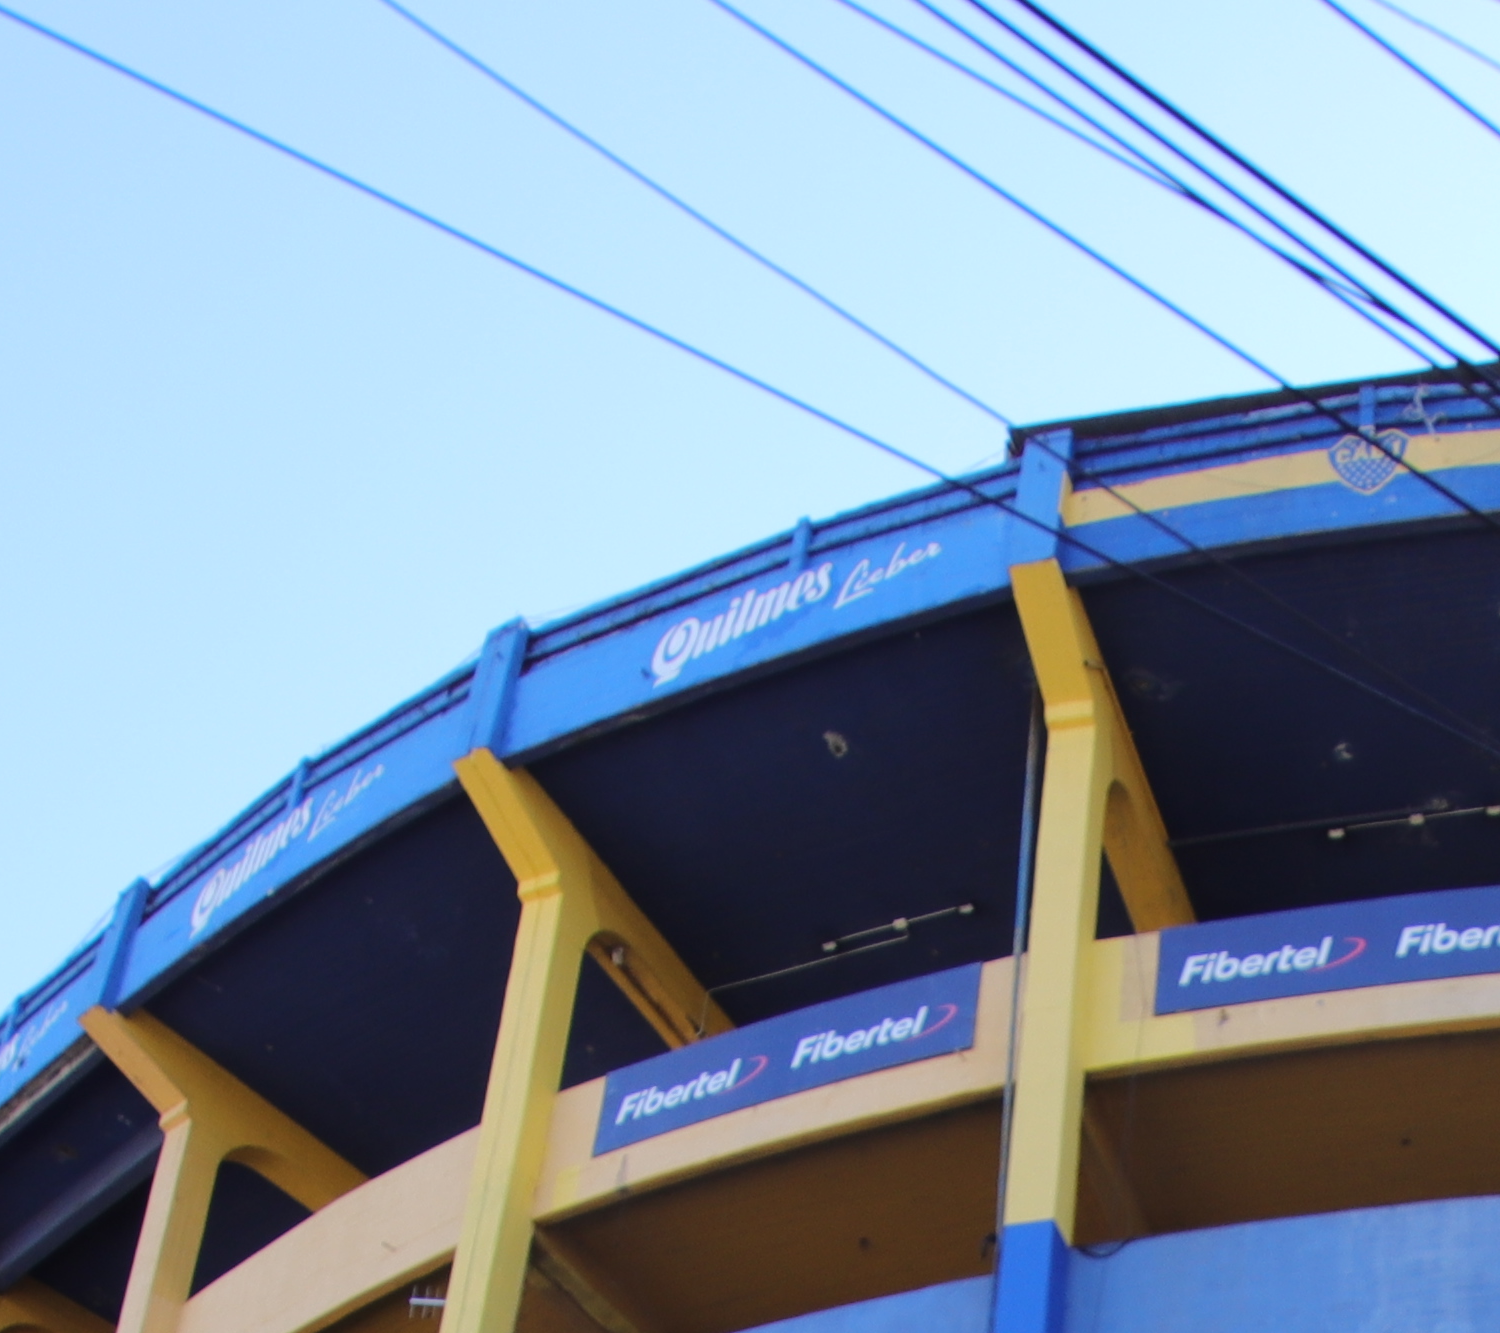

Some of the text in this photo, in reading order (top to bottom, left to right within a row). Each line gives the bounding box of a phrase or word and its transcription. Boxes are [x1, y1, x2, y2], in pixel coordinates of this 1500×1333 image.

[650, 562, 833, 689] Quilmes
[188, 796, 314, 940] Quilmes
[1177, 935, 1334, 988] Fibertel
[614, 1004, 930, 1126] Fibertel Fibertel
